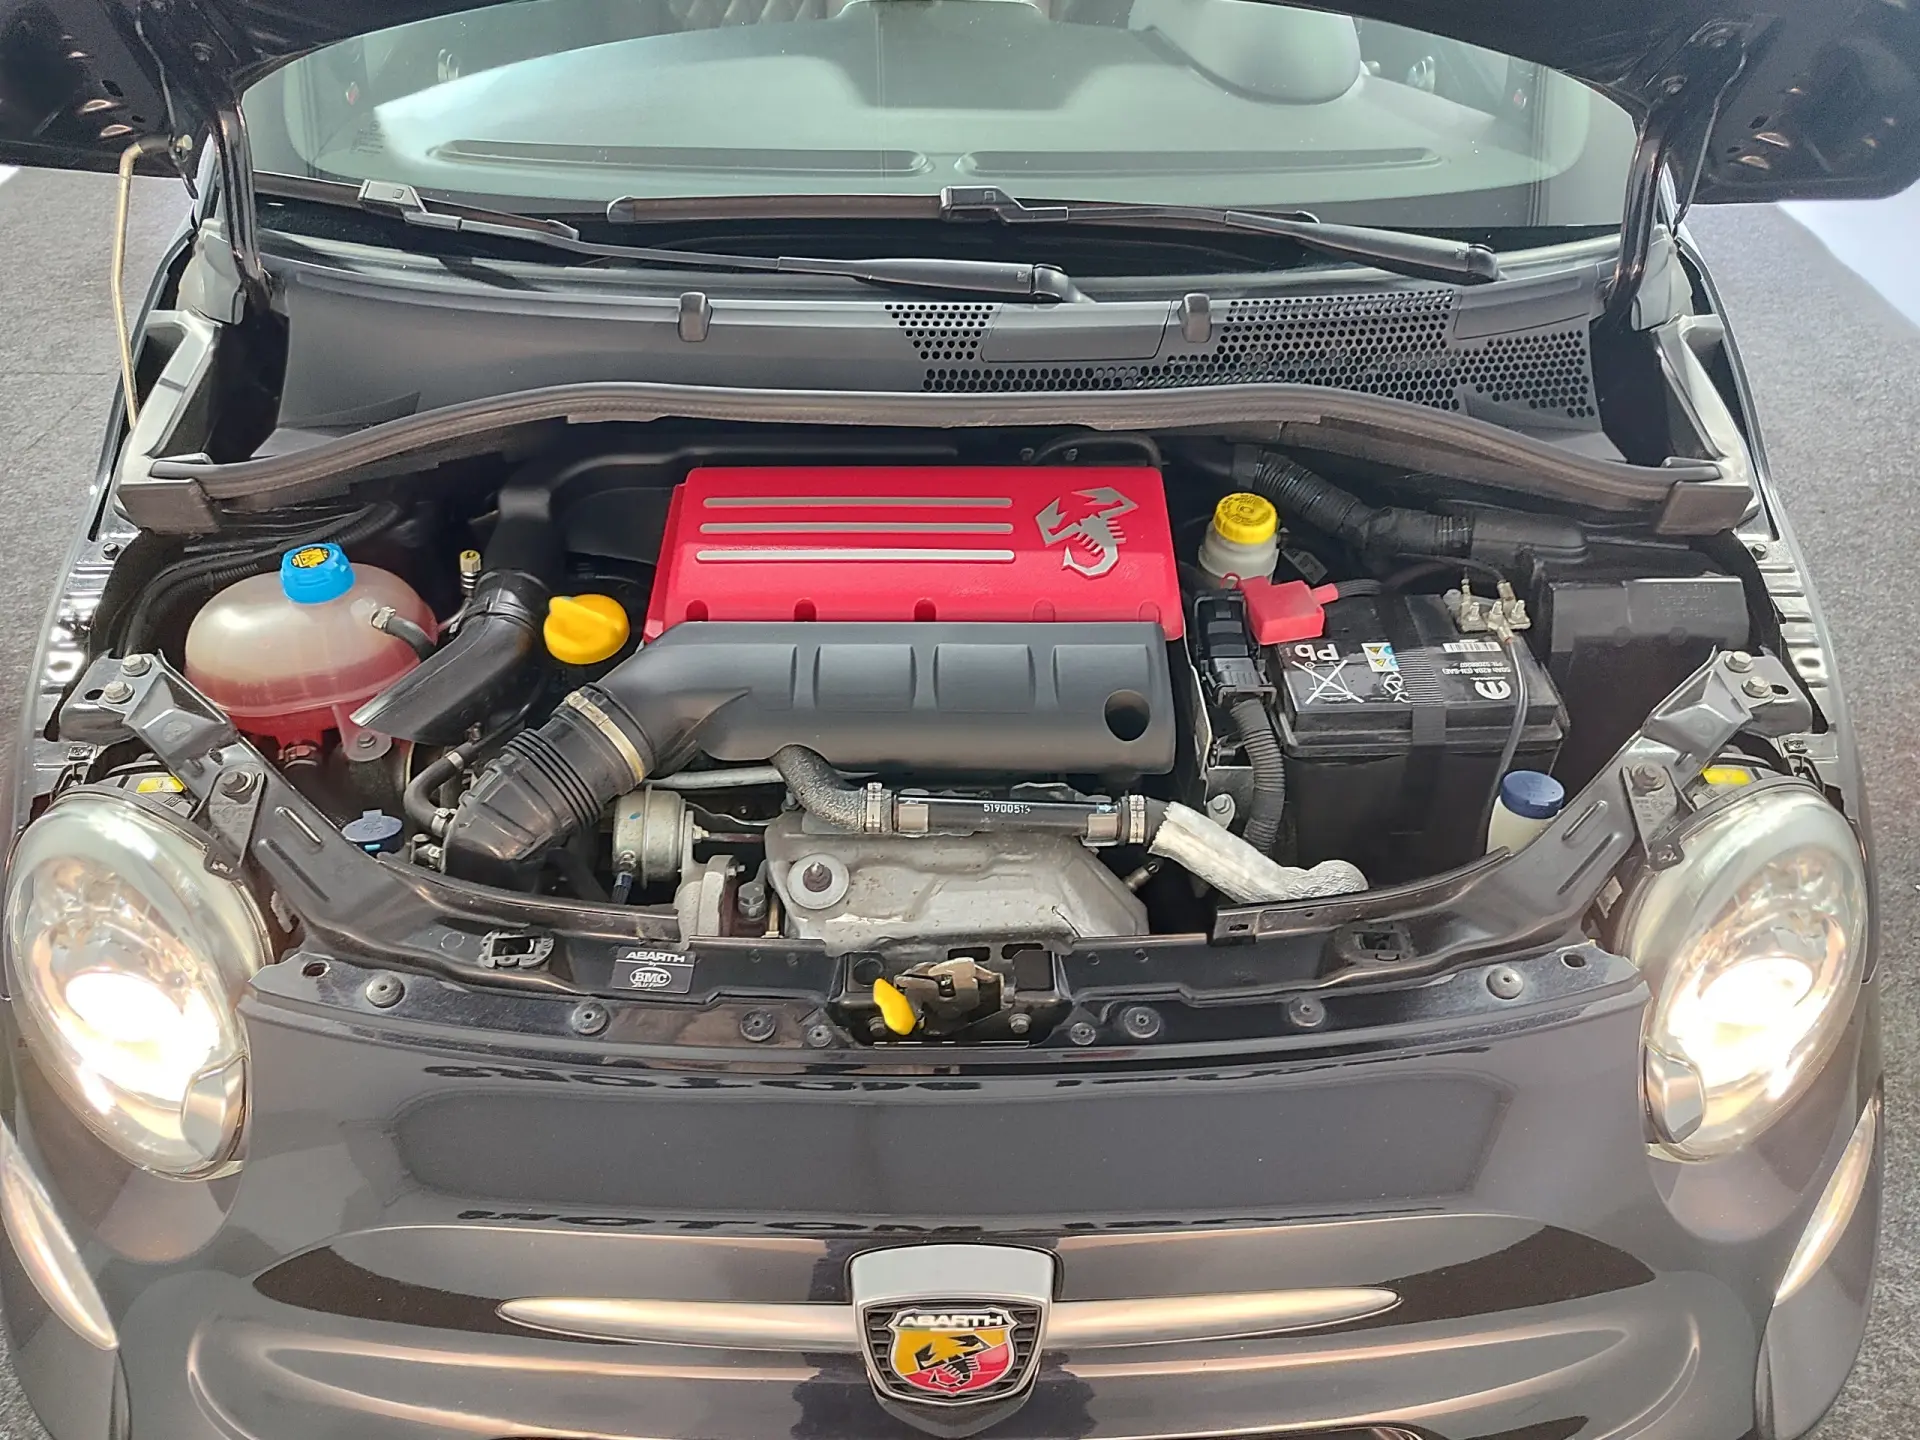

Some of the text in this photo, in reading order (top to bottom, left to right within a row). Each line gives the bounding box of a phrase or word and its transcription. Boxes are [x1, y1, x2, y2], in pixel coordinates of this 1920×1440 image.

[1293, 643, 1340, 661] Pb
[625, 951, 686, 962] ABARTH
[634, 972, 667, 983] BMC
[900, 1315, 1003, 1327] ABARTH
